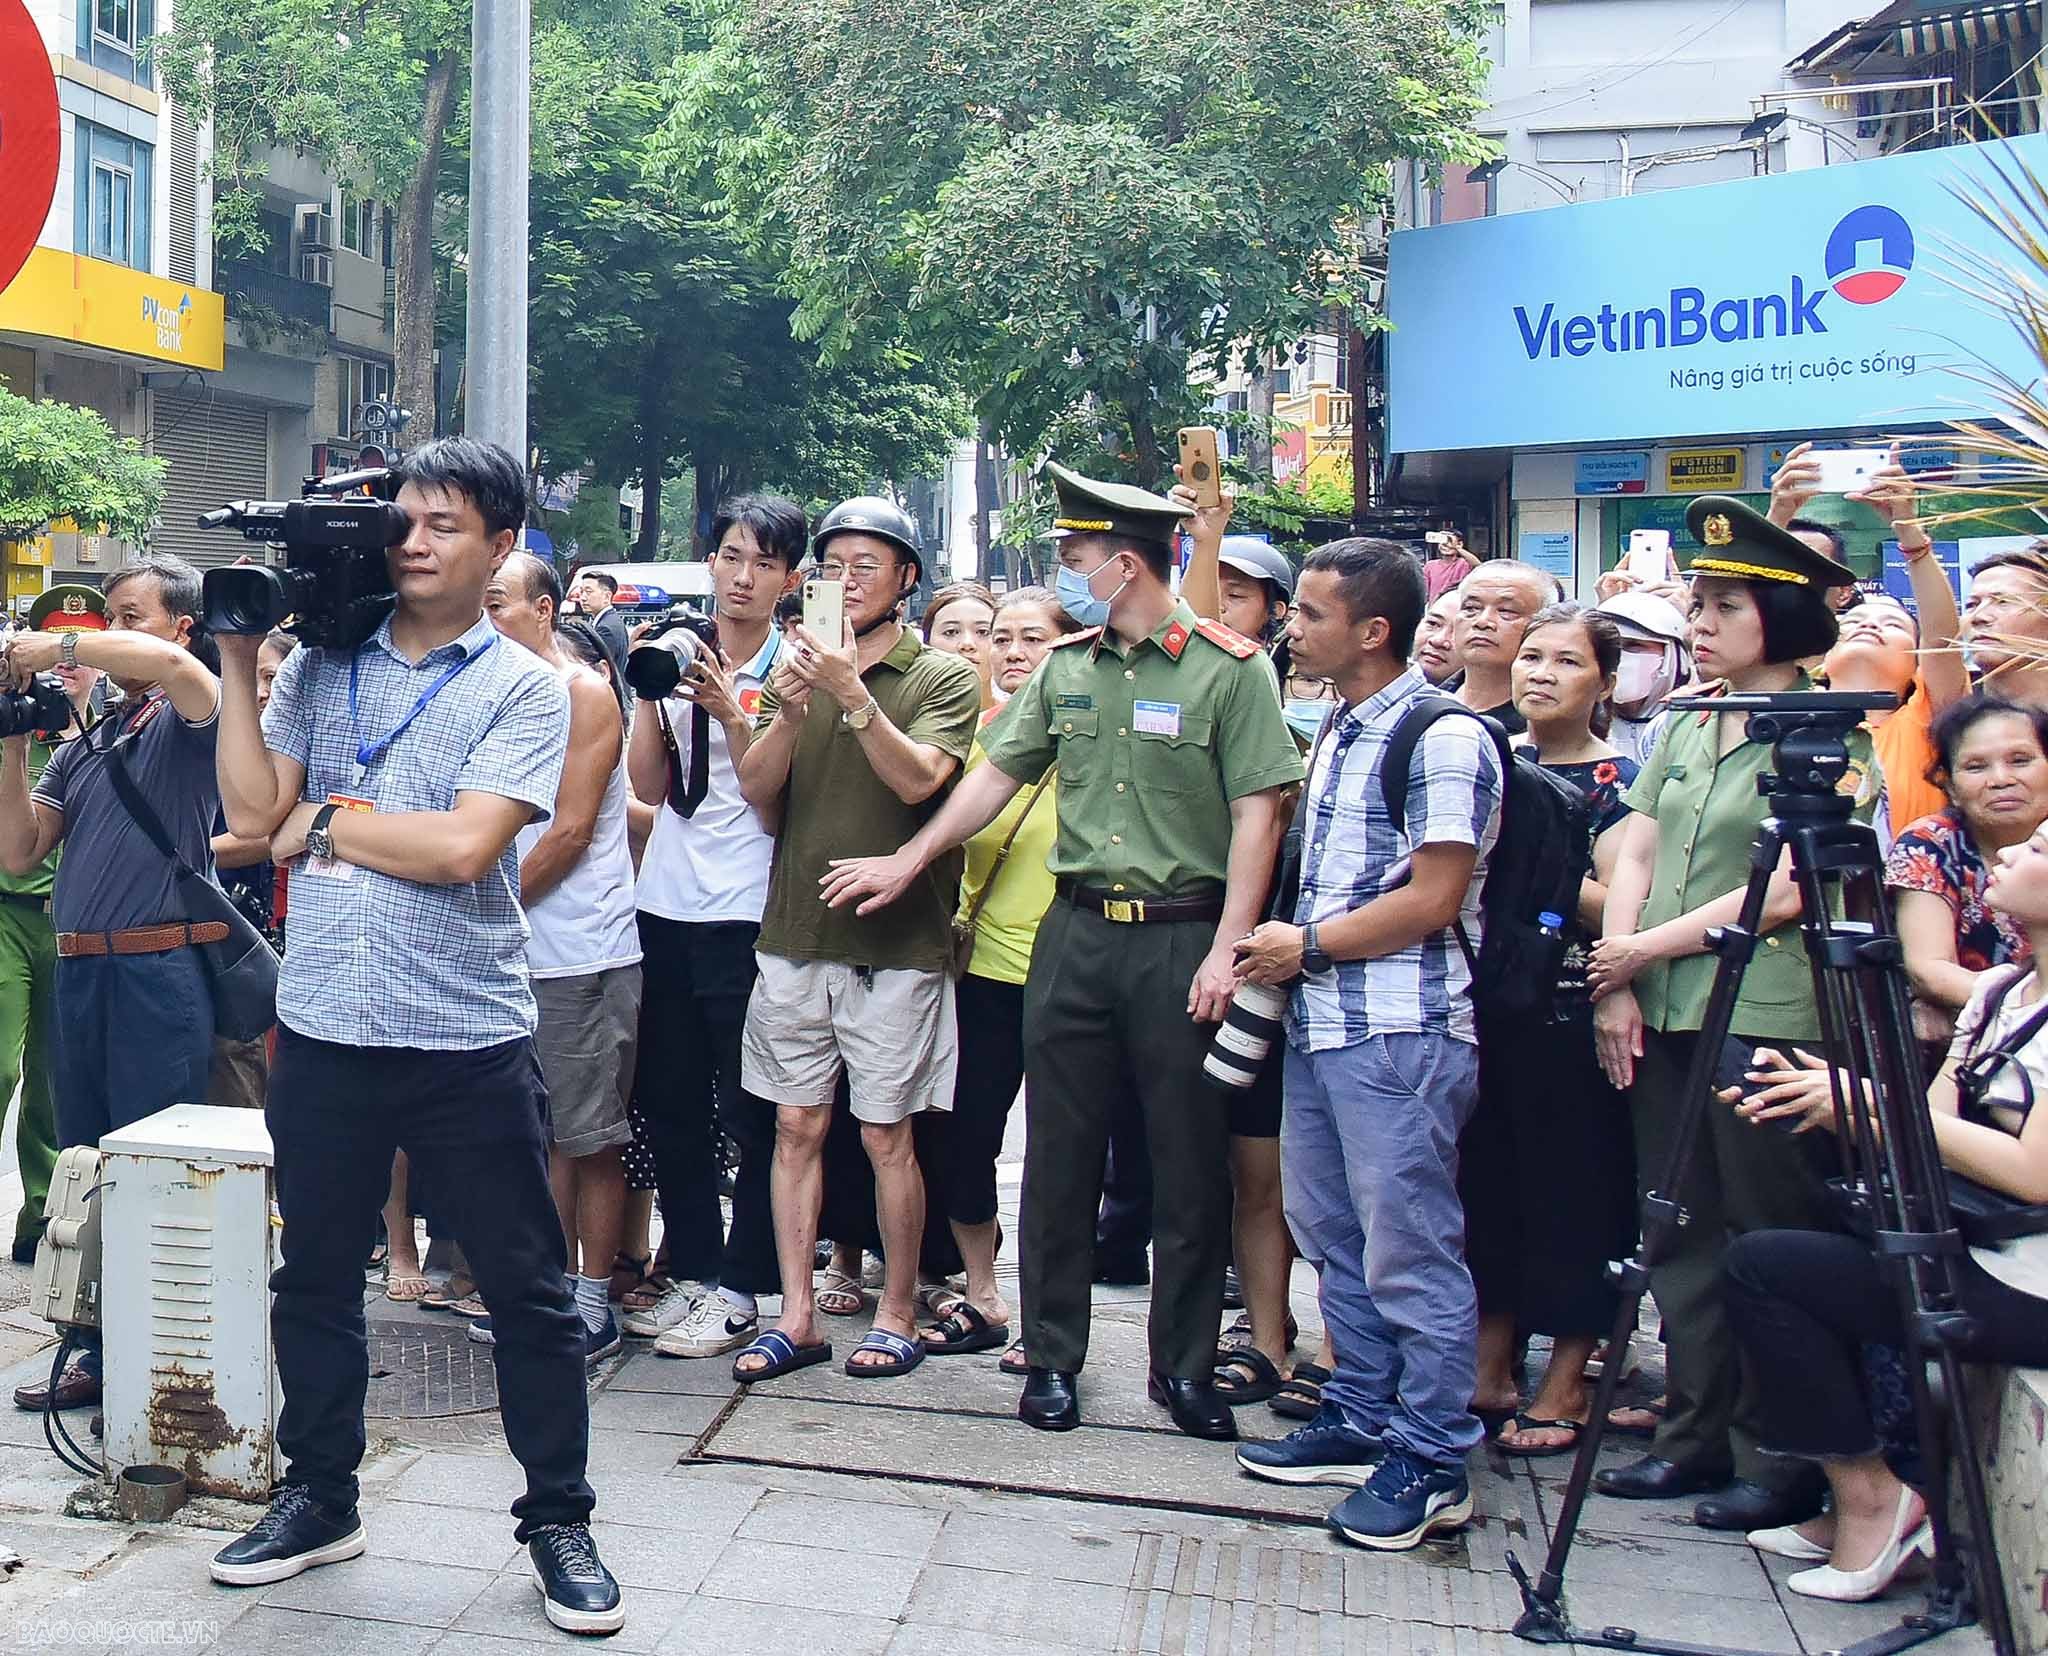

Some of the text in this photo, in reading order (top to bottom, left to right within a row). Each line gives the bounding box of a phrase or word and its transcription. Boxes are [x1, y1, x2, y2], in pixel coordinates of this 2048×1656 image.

[156, 327, 183, 353] Bank
[1669, 349, 1916, 391] Nâng giá trị cuộc sống
[1671, 456, 1725, 467] WESTERN
[1688, 465, 1725, 475] UNION
